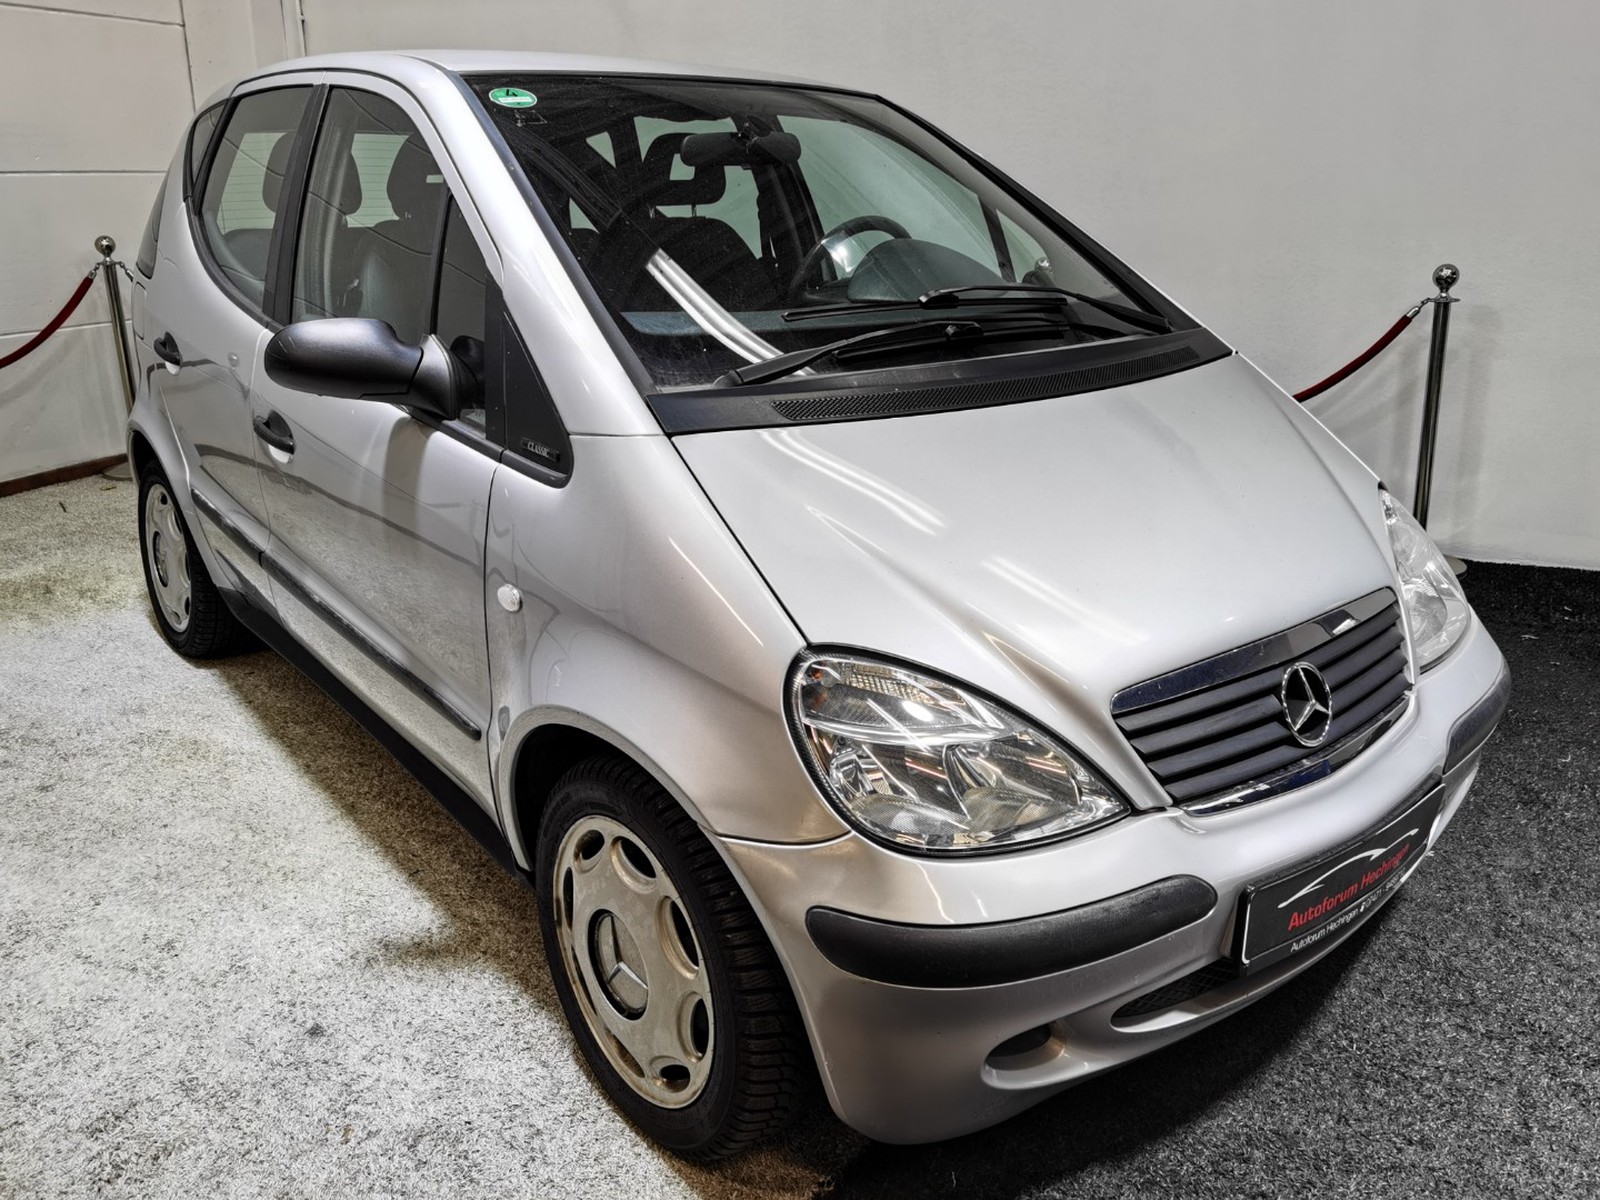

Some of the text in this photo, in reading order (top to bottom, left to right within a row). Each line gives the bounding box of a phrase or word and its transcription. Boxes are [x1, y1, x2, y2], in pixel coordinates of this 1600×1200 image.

[527, 441, 550, 458] CLASSIC
[1288, 883, 1359, 932] Autoforum
[1290, 928, 1326, 952] Autoforum
[1326, 908, 1359, 933] Hechingen
